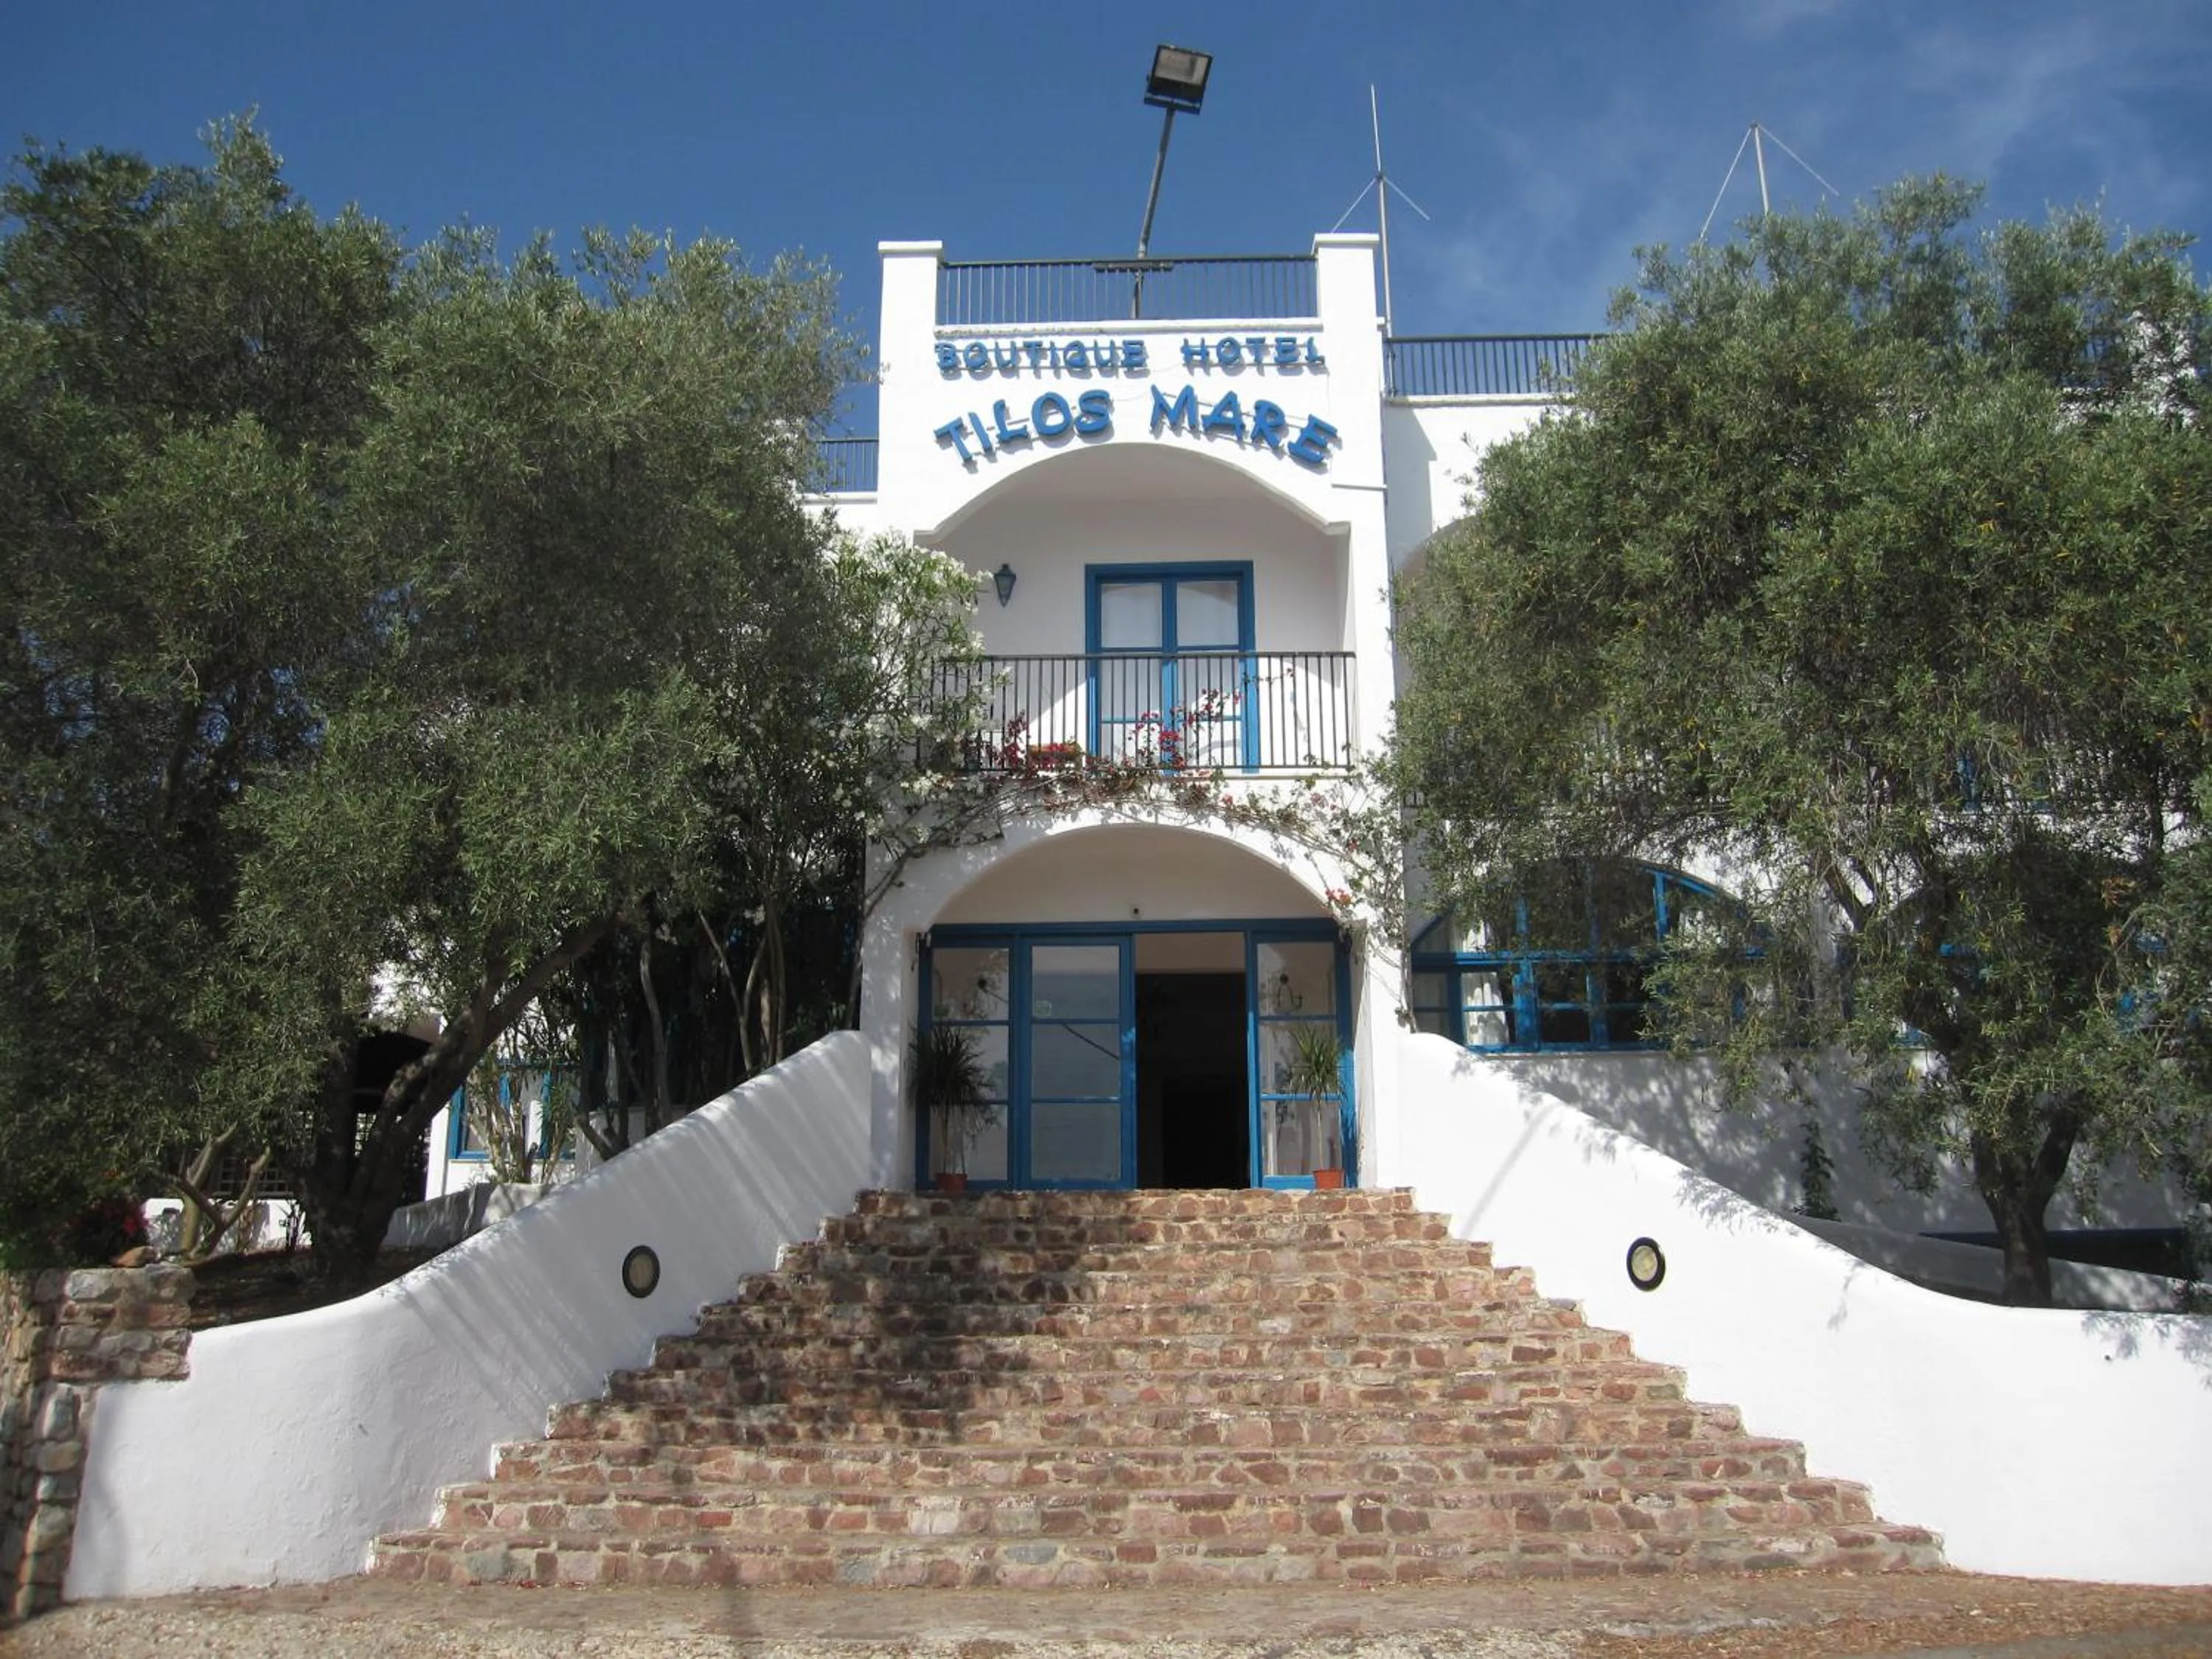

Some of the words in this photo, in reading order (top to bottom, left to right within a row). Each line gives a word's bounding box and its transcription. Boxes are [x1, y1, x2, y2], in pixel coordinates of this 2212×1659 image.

[935, 340, 1147, 370] BOUTIQUE
[1180, 336, 1325, 366] HOTEL
[933, 389, 1111, 462] TILOS
[1150, 384, 1338, 462] MARE
